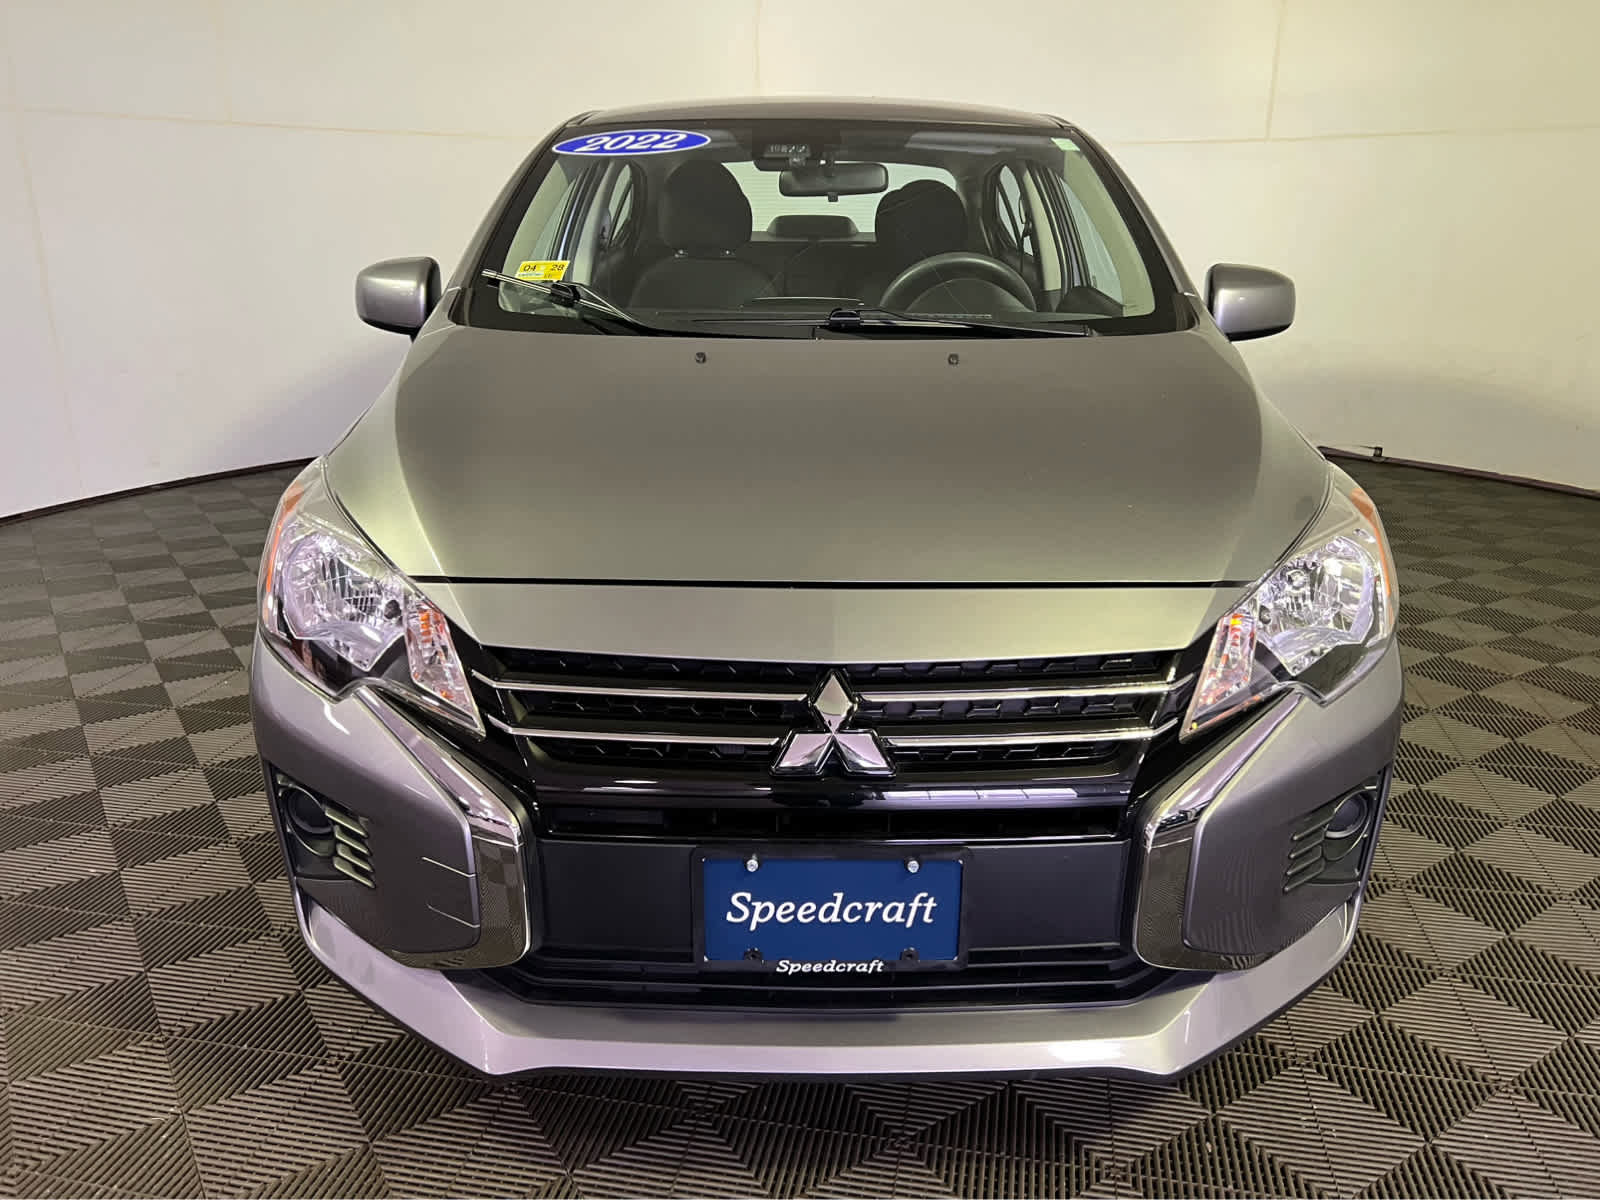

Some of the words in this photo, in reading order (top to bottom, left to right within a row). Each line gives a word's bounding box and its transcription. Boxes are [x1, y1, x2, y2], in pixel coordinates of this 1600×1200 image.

[575, 133, 687, 152] 2022
[523, 264, 536, 272] 04
[726, 892, 937, 931] Speedcraft
[776, 960, 885, 975] Speedcraft
